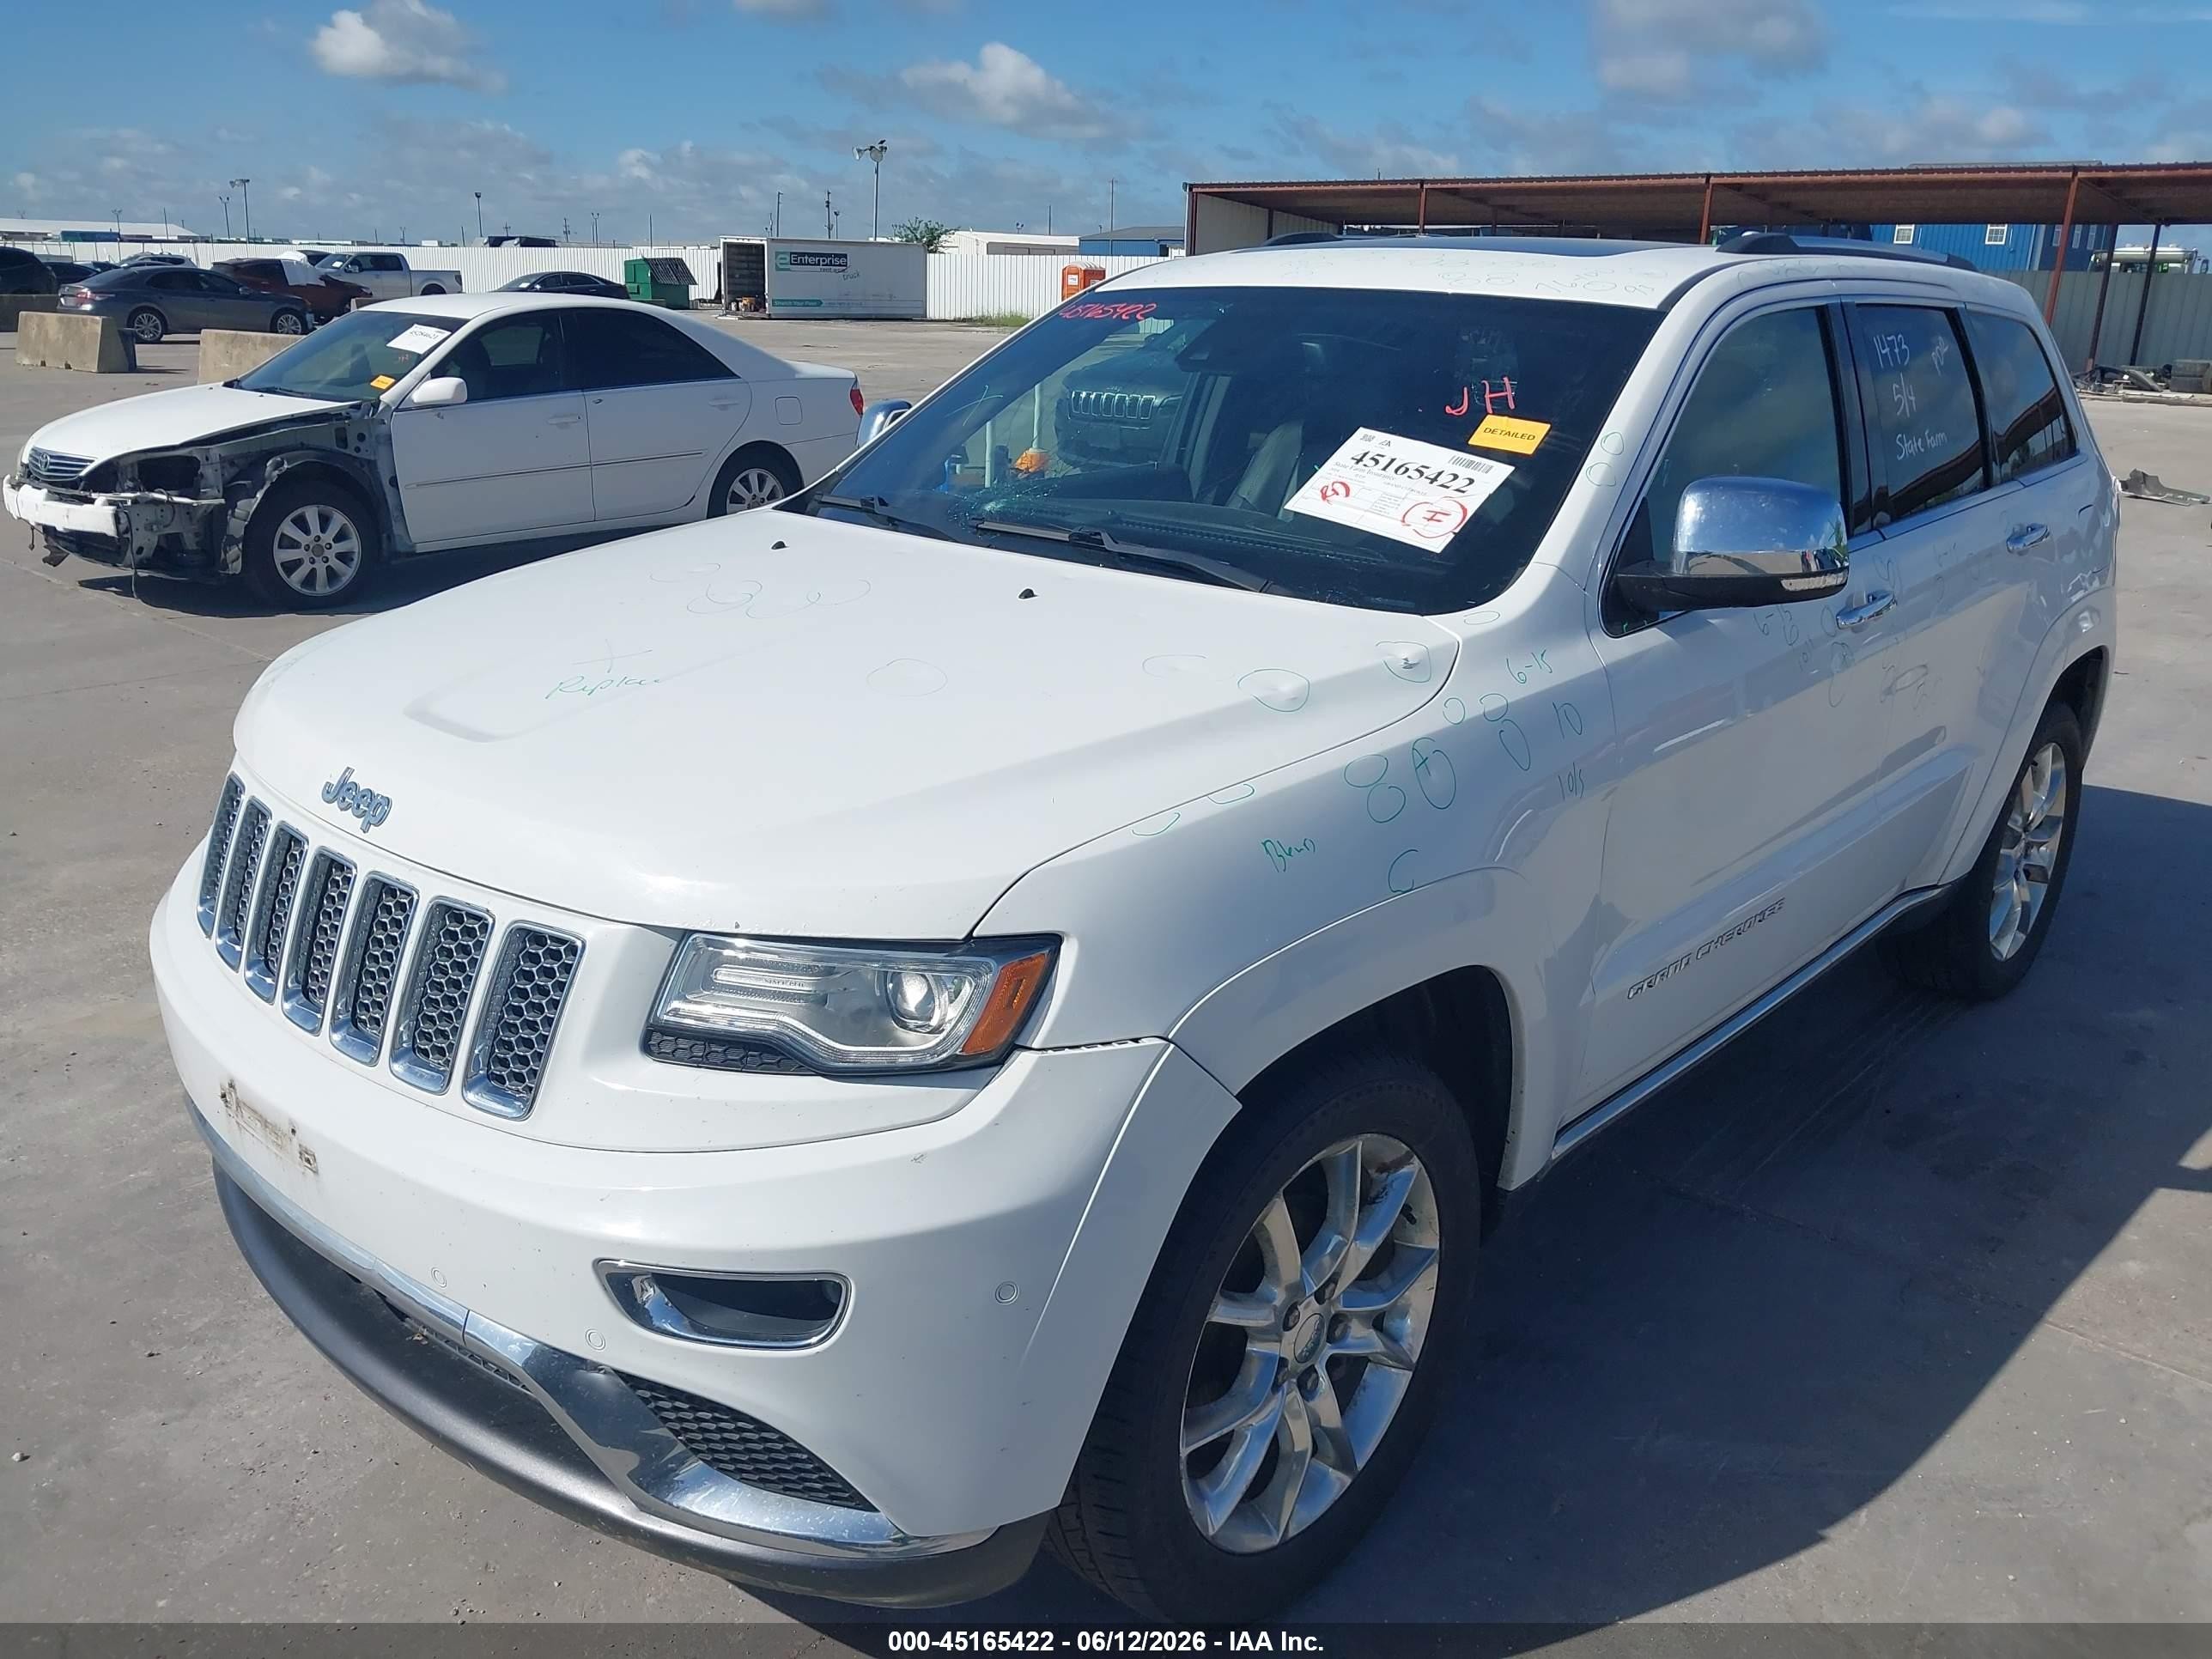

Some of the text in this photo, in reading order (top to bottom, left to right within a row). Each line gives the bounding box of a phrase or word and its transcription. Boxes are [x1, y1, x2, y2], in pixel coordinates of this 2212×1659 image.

[791, 254, 847, 266] Enterprise
[1873, 333, 1911, 369] 1473
[1893, 373, 1917, 417] 5/4
[1483, 426, 1536, 441] DETAILED
[1895, 431, 1925, 461] State
[1350, 449, 1476, 495] 45165422
[321, 766, 392, 834] Jeep
[1626, 896, 1786, 1000] GRAND CHEROKEE
